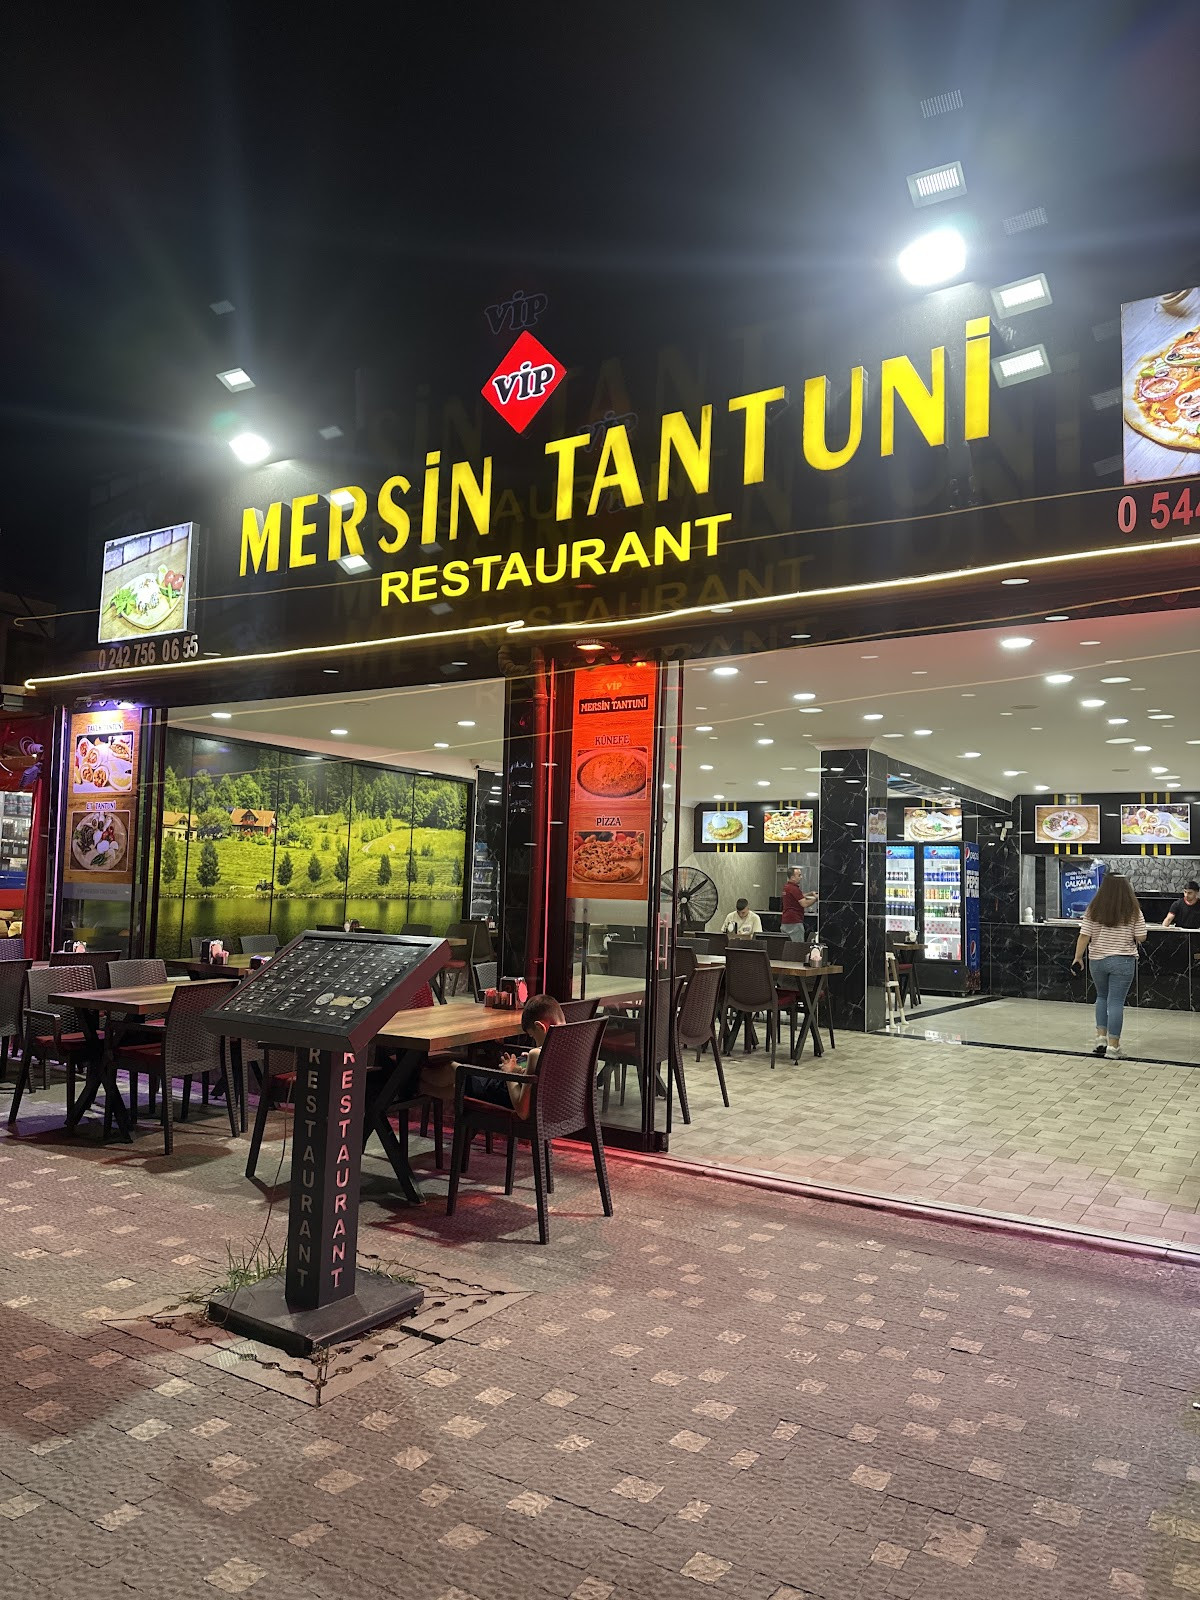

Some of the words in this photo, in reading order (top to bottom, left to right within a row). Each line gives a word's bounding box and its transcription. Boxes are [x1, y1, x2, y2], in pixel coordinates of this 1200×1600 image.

[493, 361, 555, 405] VİP
[240, 450, 492, 577] MERSİN
[545, 316, 990, 521] TANTUNİ
[1117, 495, 1137, 533] 0
[1150, 487, 1200, 530] 54
[381, 513, 733, 607] RESTAURANT
[98, 649, 106, 671] 0
[108, 645, 131, 669] 242
[133, 641, 156, 665] 756
[162, 637, 180, 662] 06
[182, 634, 199, 659] 55
[580, 699, 610, 712] MERSİN
[611, 697, 647, 710] TANTUNİ
[595, 734, 630, 746] KÜNEFE
[596, 815, 621, 827] PİZZA
[297, 1047, 321, 1288] RESTAURANT
[330, 1052, 355, 1288] RESTAURANT
